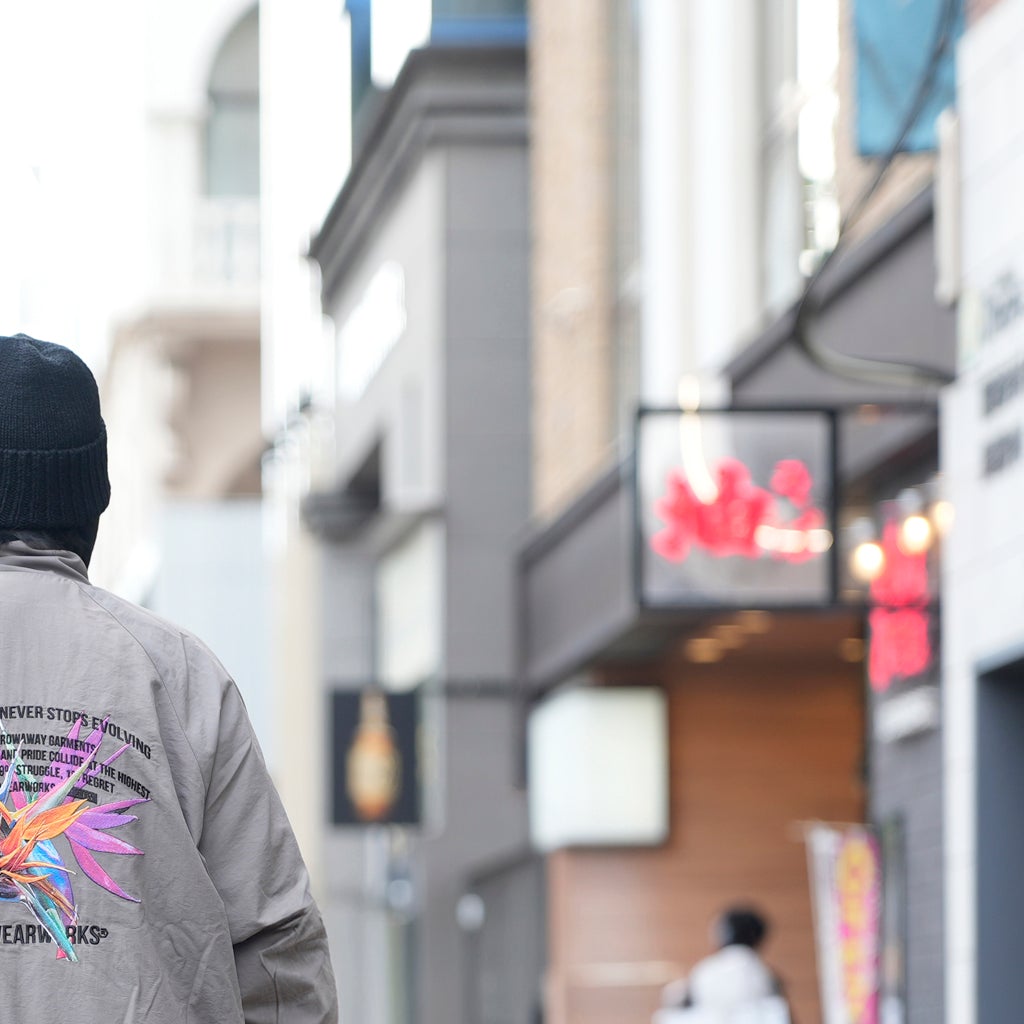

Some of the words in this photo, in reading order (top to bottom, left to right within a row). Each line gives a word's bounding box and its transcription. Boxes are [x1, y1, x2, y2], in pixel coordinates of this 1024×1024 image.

[0, 705, 43, 719] NEVER
[47, 707, 88, 727] STOPS
[92, 716, 151, 760] EVOLVING
[16, 764, 63, 779] STRUGGLE,
[82, 773, 116, 794] REGRET
[21, 749, 47, 761] PRIDE
[100, 763, 115, 780] THE
[117, 771, 151, 799] HIGHEST
